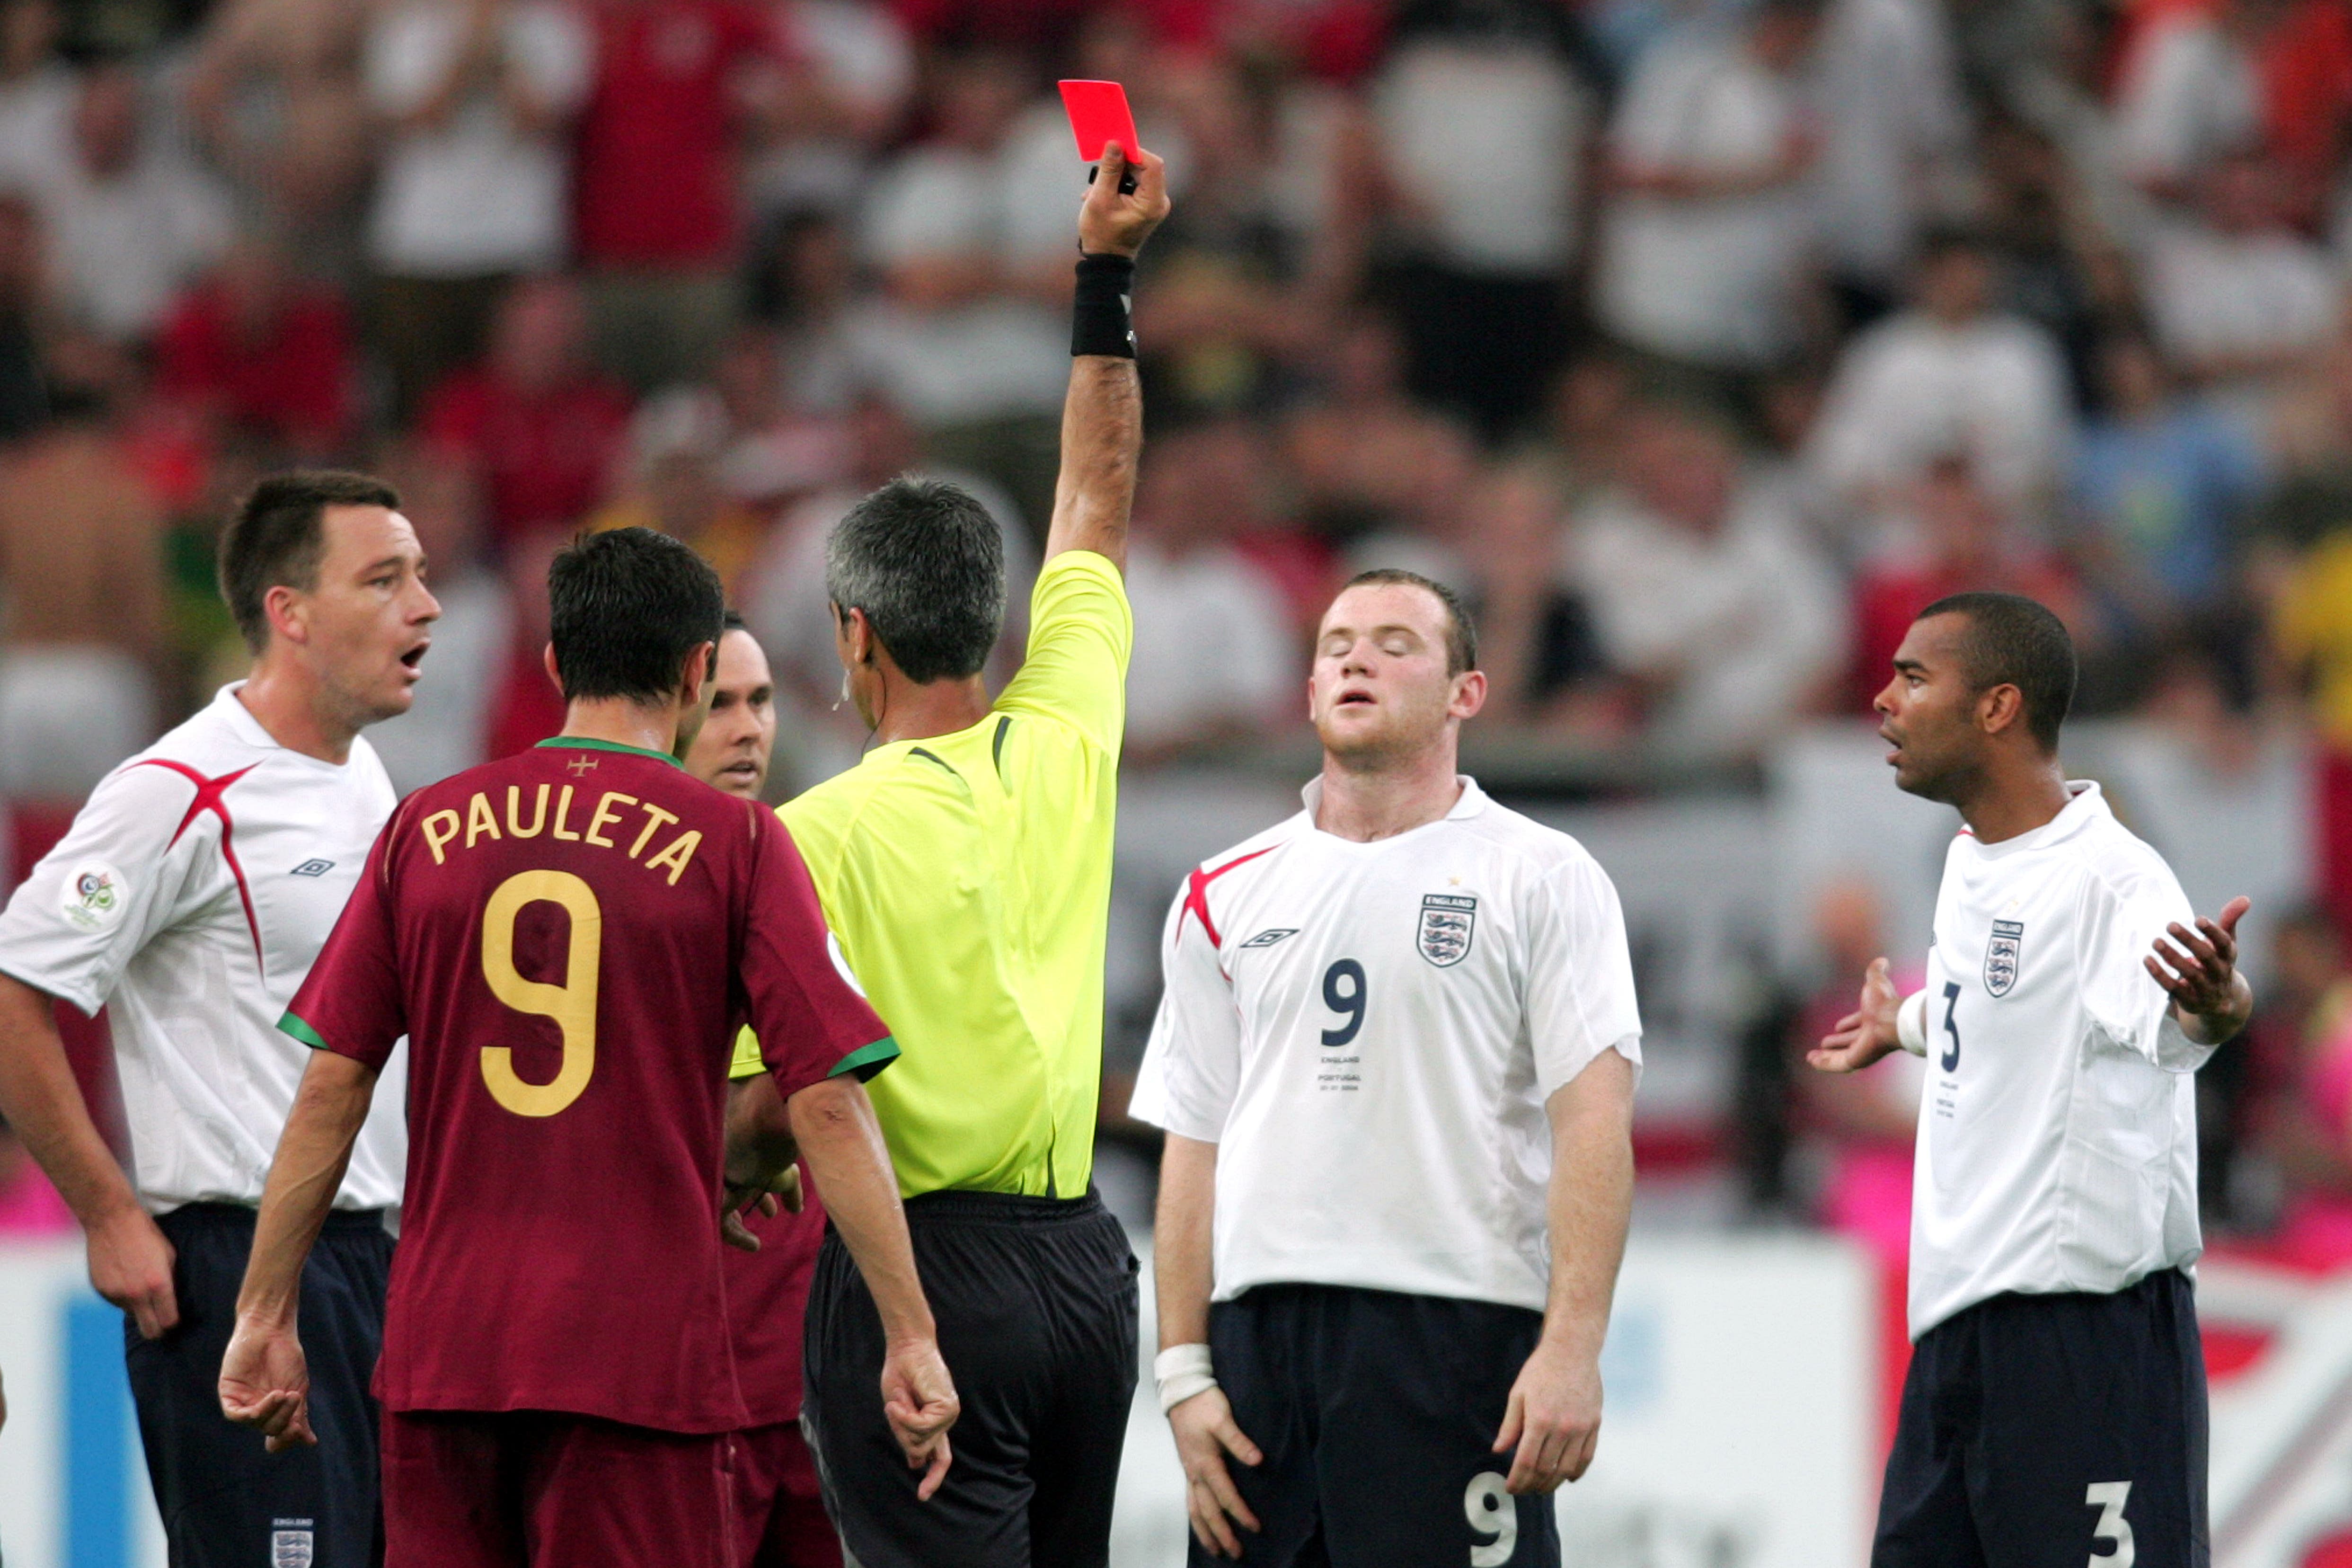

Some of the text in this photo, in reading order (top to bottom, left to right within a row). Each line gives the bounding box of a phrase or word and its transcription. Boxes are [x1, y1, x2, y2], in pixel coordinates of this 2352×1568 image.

[421, 784, 703, 886] PAULETA
[1425, 896, 1473, 907] ENGLAND
[480, 869, 601, 1117] 9
[1321, 958, 1367, 1047] 9
[1941, 982, 1961, 1072] 3
[1464, 1471, 1518, 1568] 9
[2085, 1480, 2135, 1568] 3
